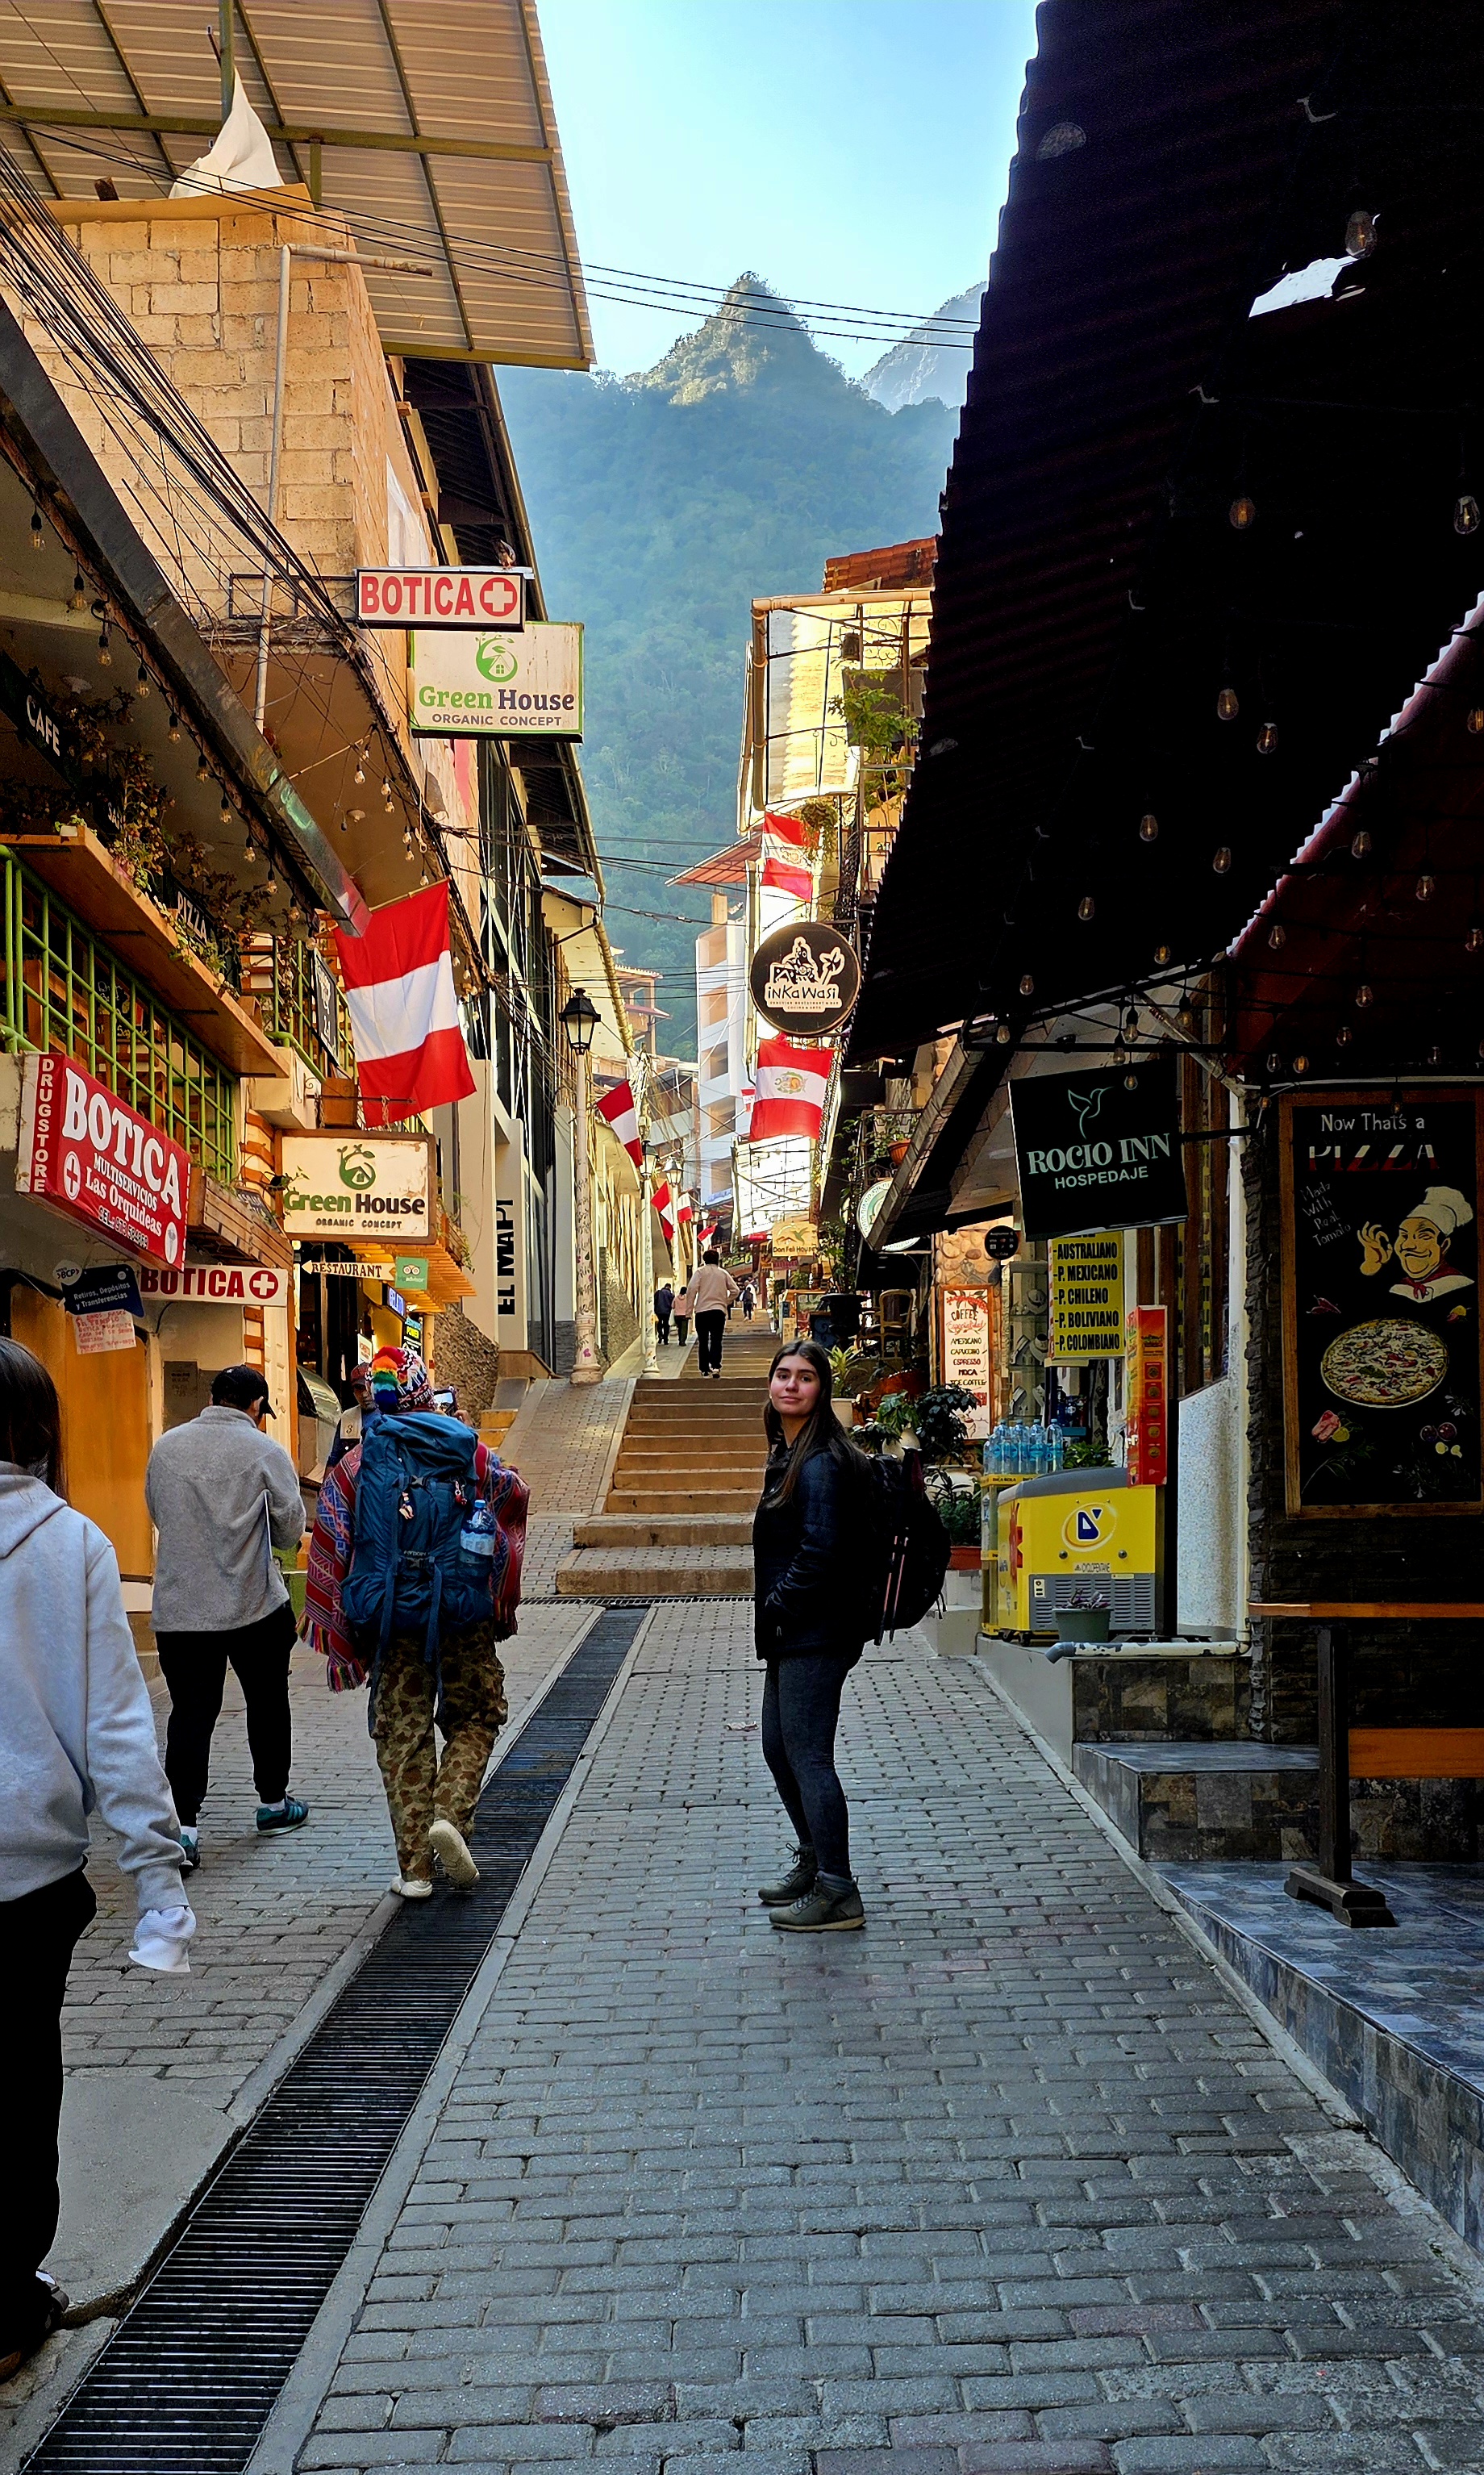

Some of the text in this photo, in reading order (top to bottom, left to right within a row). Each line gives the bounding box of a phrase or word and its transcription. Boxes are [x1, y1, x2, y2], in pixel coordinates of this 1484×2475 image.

[361, 575, 476, 616] BOTICA
[419, 686, 575, 711] Green House
[26, 694, 60, 757] CAFE
[431, 713, 561, 726] ORGANIC CONCEPT
[177, 891, 207, 944] PIZZA
[34, 1058, 54, 1193] DRUGSTORE
[1321, 1112, 1426, 1132] Now That's a
[62, 1067, 182, 1220] BOTICA
[1026, 1133, 1171, 1175] ROCIO INN
[1307, 1142, 1440, 1172] PIZZA
[94, 1152, 157, 1212] MULTISERVICIOS
[1054, 1166, 1149, 1190] HOSPEDAJE
[85, 1166, 162, 1237] Las Orquideas
[284, 1190, 425, 1215] Green House
[1302, 1198, 1332, 1217] With
[315, 1218, 402, 1229] ORGANIC CONCEPT
[1312, 1223, 1352, 1247] Tomato
[495, 1199, 516, 1316] EL MAPI
[311, 1262, 383, 1279] RESTAURANT
[1067, 1264, 1118, 1281] MEXICANO
[73, 1282, 131, 1300] Retiros, Depósitos
[140, 1267, 244, 1300] BOTICA
[76, 1292, 128, 1311] y Transferencias
[1067, 1288, 1109, 1304] CHILENO
[951, 1309, 979, 1321] COFFEE
[1068, 1310, 1119, 1328] BOLIVIANO
[950, 1337, 982, 1346] AMERICANO
[1067, 1333, 1119, 1351] COLOMBIANO
[953, 1358, 981, 1366] ESPRESSO
[958, 1368, 978, 1376] MOCA
